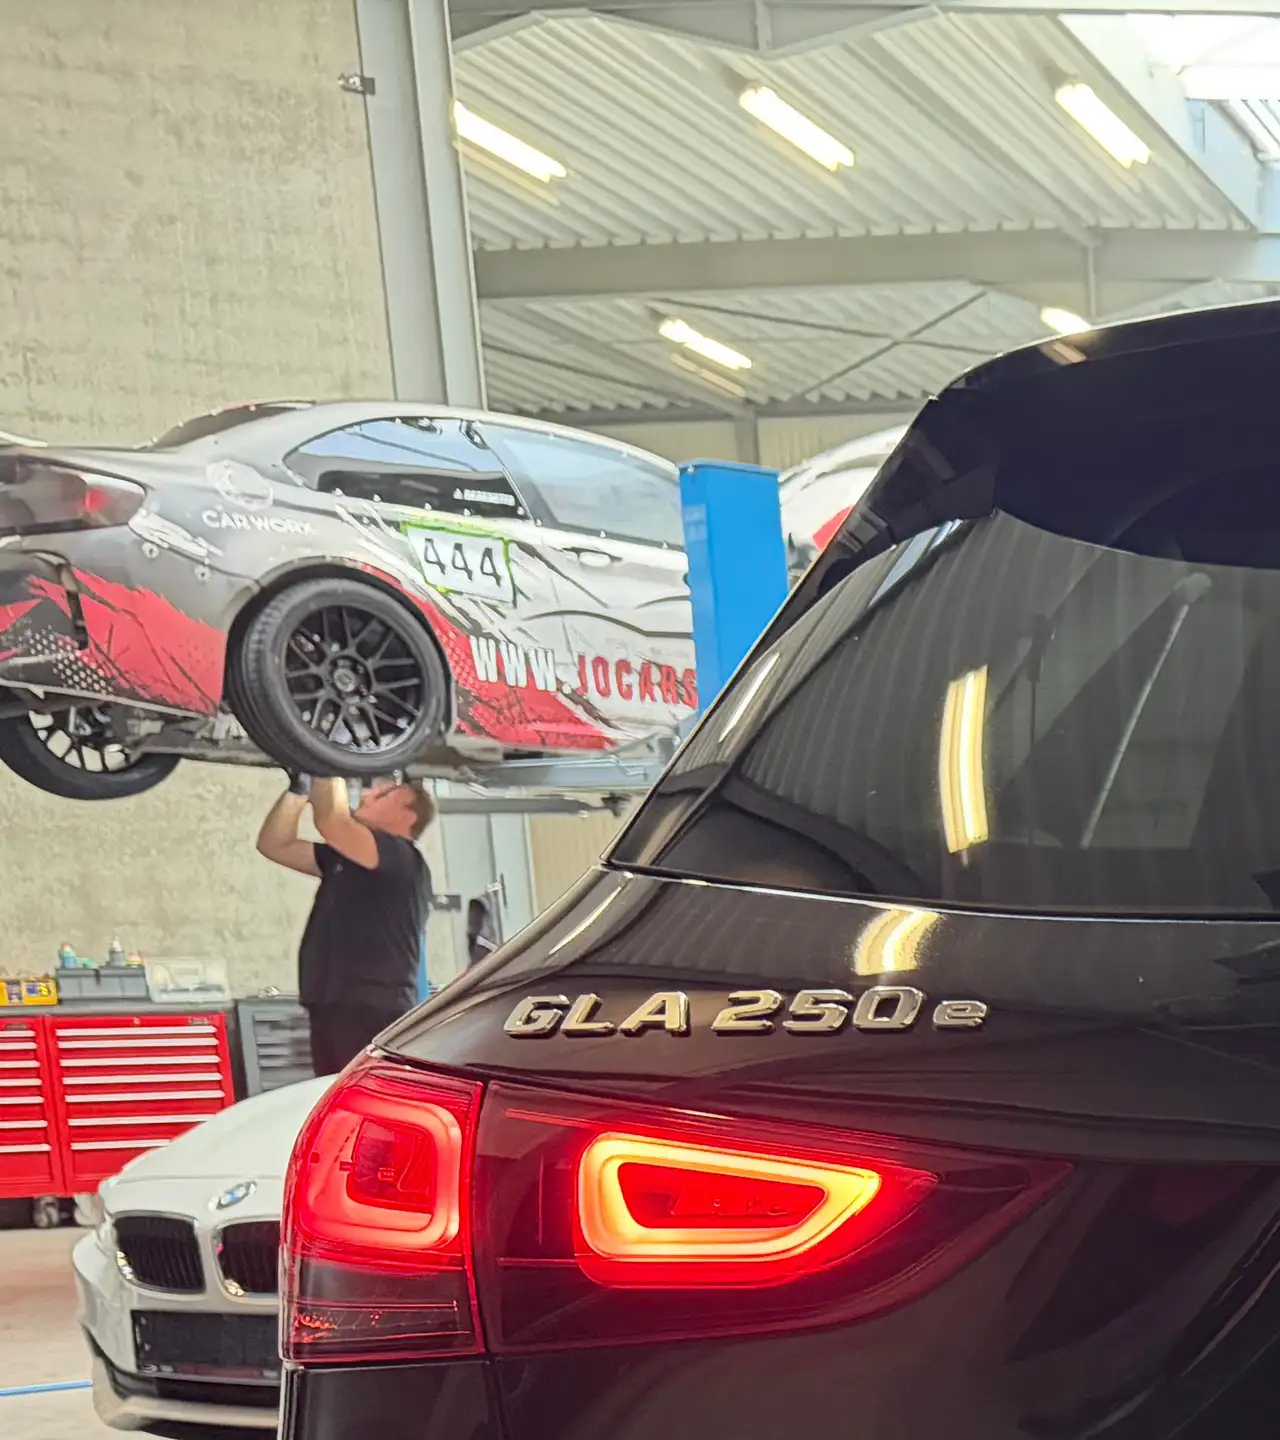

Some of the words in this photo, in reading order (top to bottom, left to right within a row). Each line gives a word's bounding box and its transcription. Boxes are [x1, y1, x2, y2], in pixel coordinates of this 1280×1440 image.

[423, 537, 502, 588] 444
[503, 990, 690, 1037] GLA
[711, 985, 922, 1033] 250
[930, 999, 987, 1029] e
